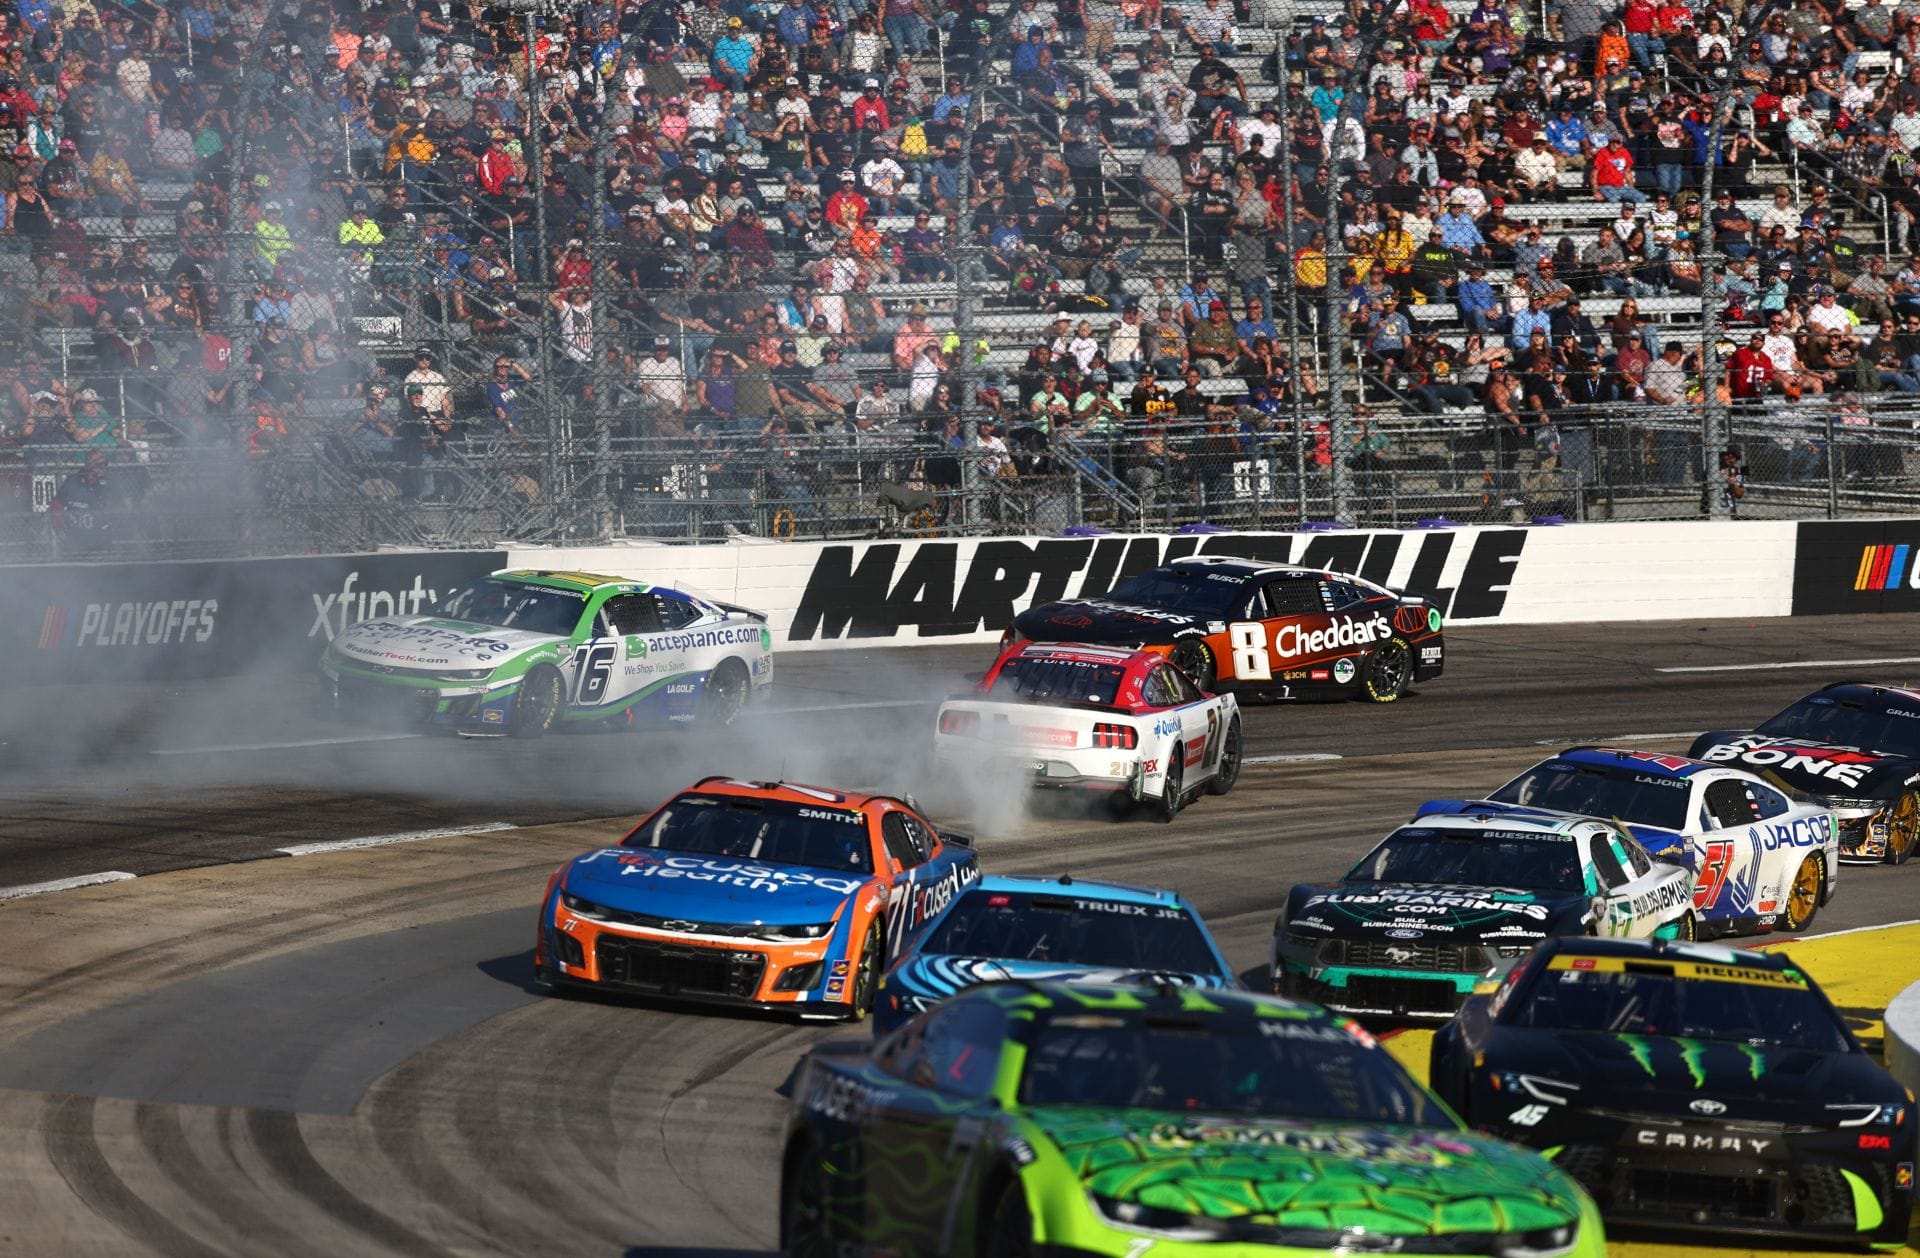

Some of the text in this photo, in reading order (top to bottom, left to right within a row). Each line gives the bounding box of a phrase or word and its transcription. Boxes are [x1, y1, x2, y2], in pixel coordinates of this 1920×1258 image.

[788, 530, 1528, 641] MARTINLLE
[1207, 573, 1245, 585] BUSCH
[77, 599, 218, 647] PLAYOFFS
[649, 627, 760, 652] acceptance.com
[1276, 611, 1392, 658] Cheddar's
[345, 643, 449, 664] WeatherTech.com
[1229, 622, 1272, 680] 8
[624, 666, 636, 675] We
[637, 664, 655, 675] Shop.
[1033, 658, 1099, 669] BURTON
[567, 643, 618, 706] 16
[676, 684, 695, 693] GOLF
[1110, 762, 1128, 776] 21
[1701, 744, 1874, 789] BONE
[1635, 775, 1684, 789] LAJOIE
[798, 808, 858, 825] SMITH
[1483, 830, 1573, 842] BUESCHER
[621, 864, 779, 893] Health
[1692, 840, 1735, 912] 51
[1379, 888, 1491, 899] BUILD
[1075, 900, 1188, 920] TRUEX JR.
[1304, 893, 1549, 920] SUBMARINES
[1387, 904, 1448, 915] .COM
[563, 919, 578, 931] 71
[1362, 921, 1454, 932] SUBMARINES.COM
[1759, 915, 1777, 925] FORD
[1309, 967, 1324, 980] 17
[1695, 965, 1800, 985] REDDICK
[1508, 1104, 1550, 1127] 45
